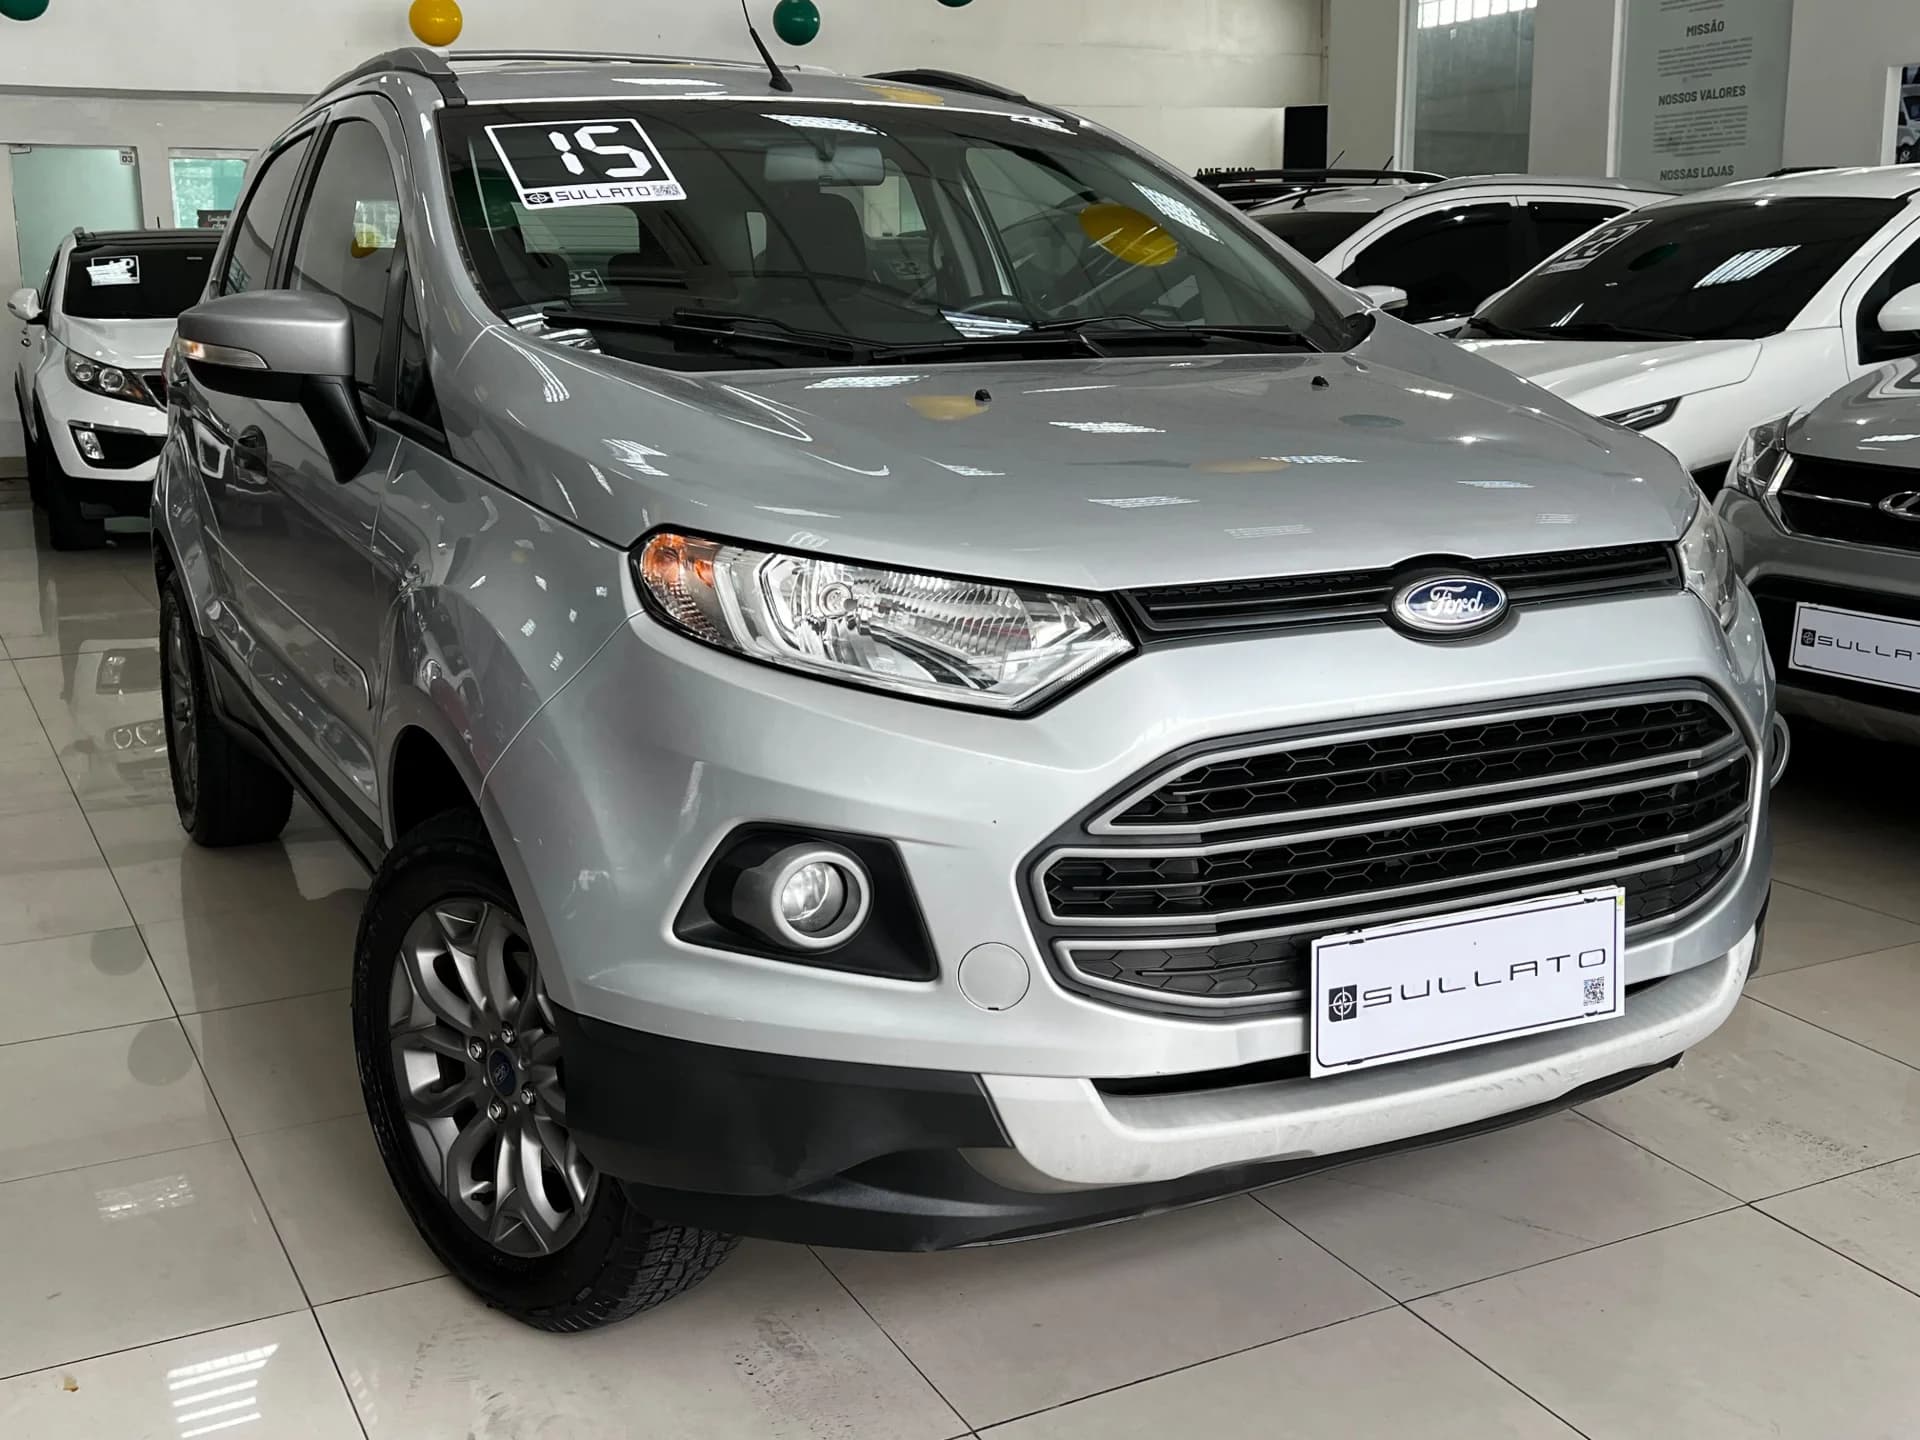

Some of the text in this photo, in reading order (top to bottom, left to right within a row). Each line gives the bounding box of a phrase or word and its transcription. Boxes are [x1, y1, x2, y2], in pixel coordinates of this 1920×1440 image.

[1686, 19, 1725, 37] MISSÃO
[1658, 85, 1746, 106] NOSSOS VALORES
[122, 155, 134, 163] 03
[548, 125, 652, 178] 15
[1660, 165, 1735, 181] NOSSAS LOJAS
[555, 186, 651, 201] SULLATO
[1427, 585, 1484, 616] Ford
[1817, 635, 1920, 661] SULLA
[1362, 948, 1606, 1009] SULLATO
